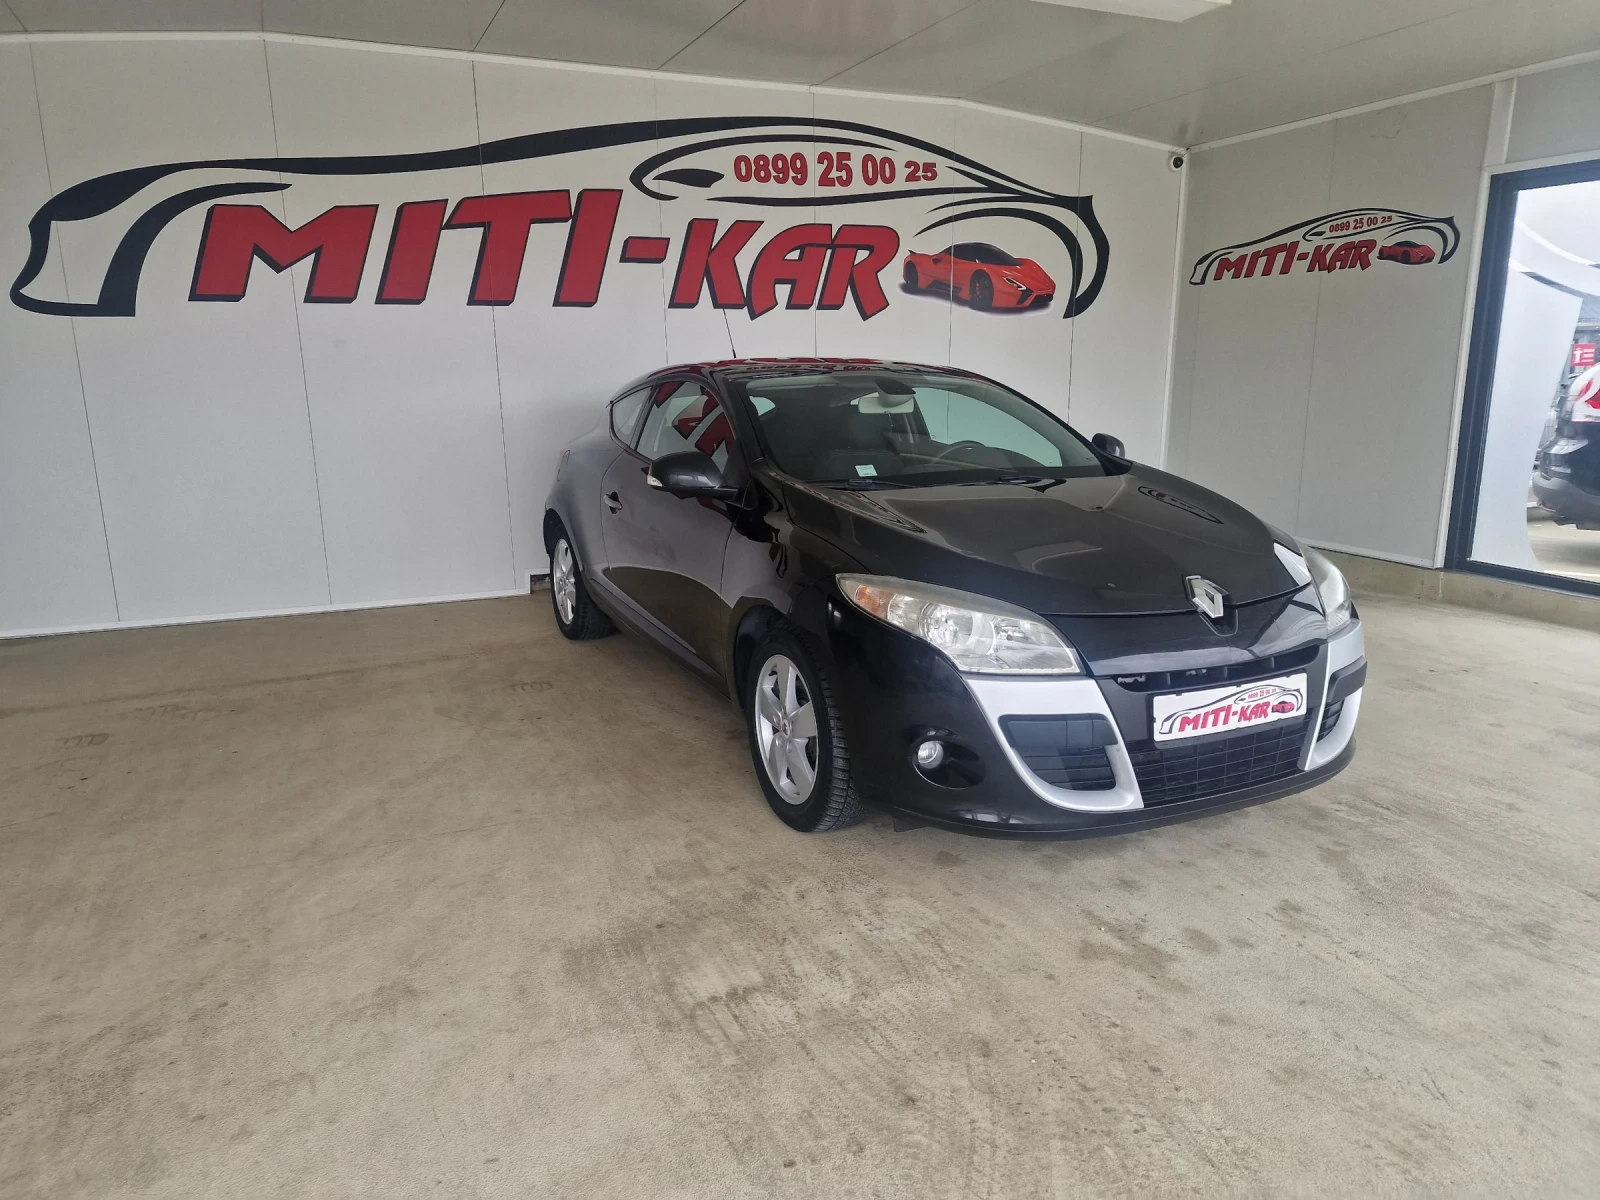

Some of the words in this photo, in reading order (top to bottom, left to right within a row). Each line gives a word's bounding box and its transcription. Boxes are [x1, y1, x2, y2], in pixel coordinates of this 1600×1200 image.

[733, 152, 809, 186] 0899
[816, 151, 854, 187] 25
[861, 153, 896, 186] 00
[904, 160, 938, 182] 25
[1328, 220, 1351, 233] 0899
[1352, 217, 1364, 230] 25
[1366, 216, 1378, 227] 00
[1380, 215, 1393, 224] 25
[188, 188, 900, 321] MITI-KAR
[1213, 239, 1377, 281] MITI-KAR
[1178, 701, 1270, 732] MITI-KAR
